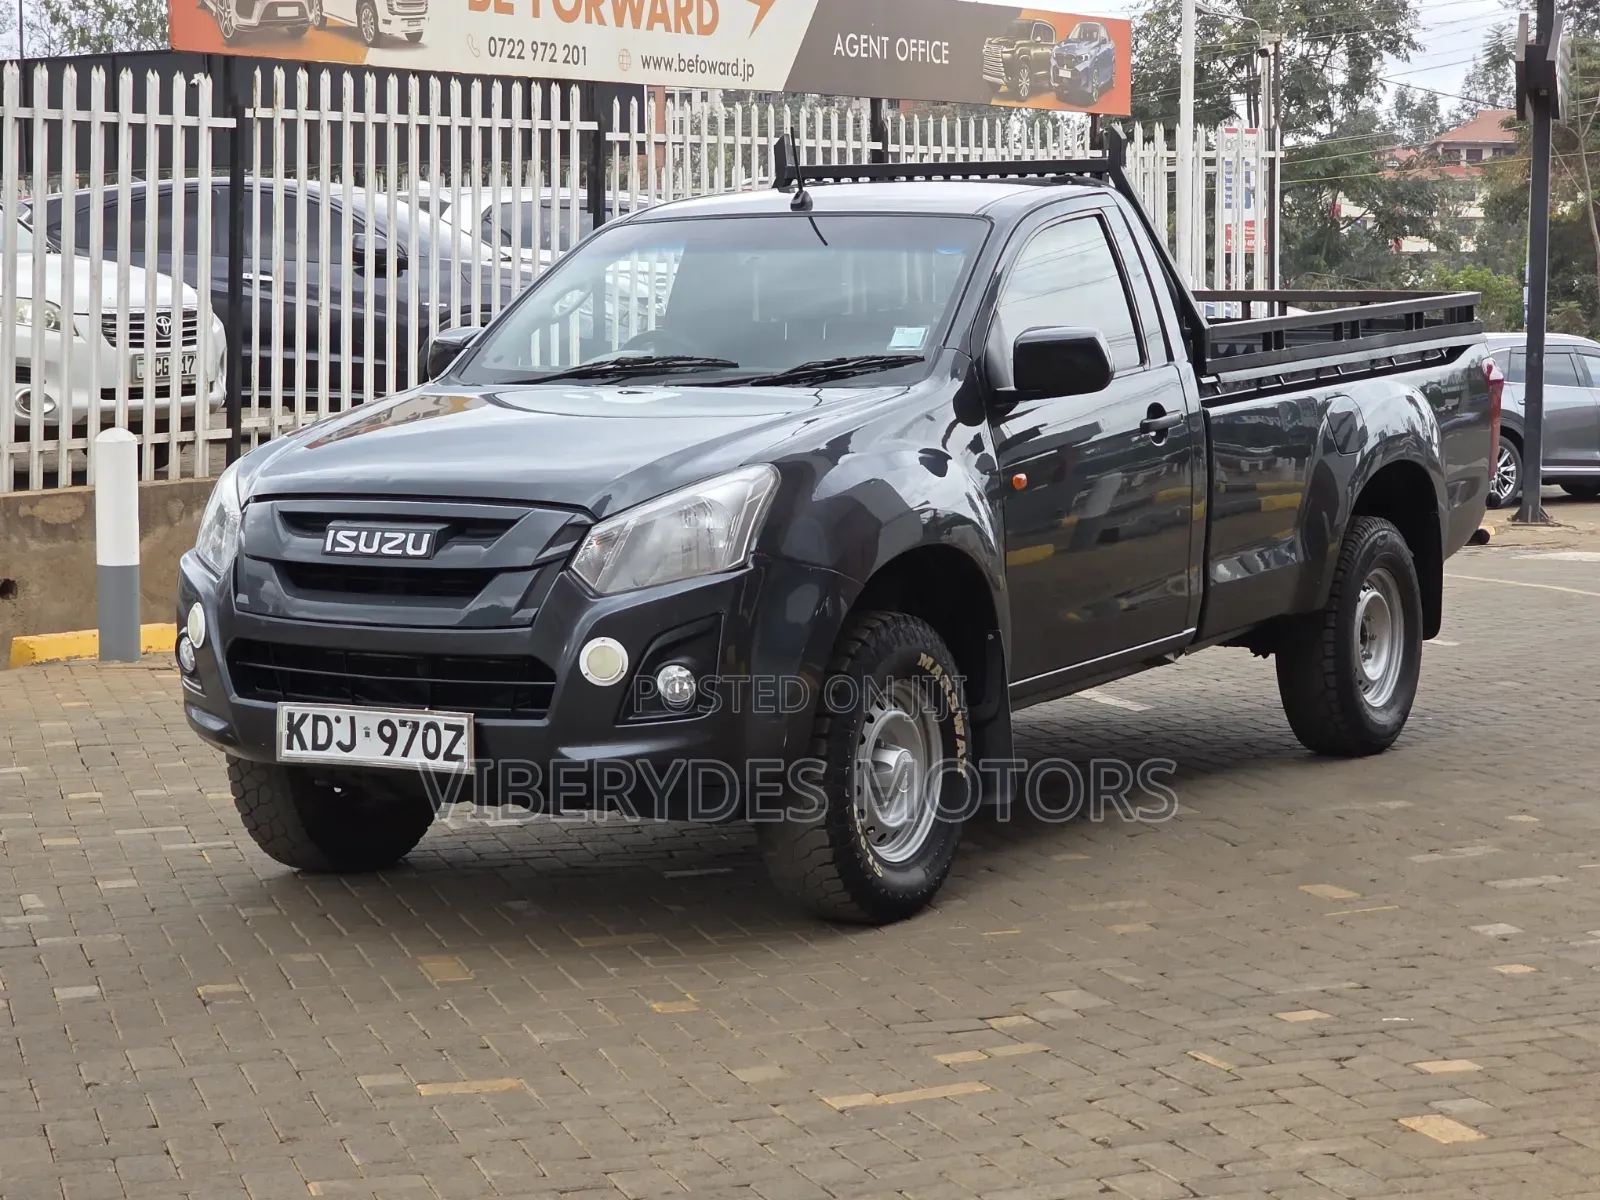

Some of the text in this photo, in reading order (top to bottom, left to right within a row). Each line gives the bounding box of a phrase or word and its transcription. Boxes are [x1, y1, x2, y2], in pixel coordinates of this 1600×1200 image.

[488, 36, 587, 66] 0722 972 201
[833, 32, 949, 64] AGENT OFFICE
[640, 53, 755, 82] www.befoward.jp
[325, 529, 432, 556] ISUZU
[285, 711, 466, 762] KDJ 970Z
